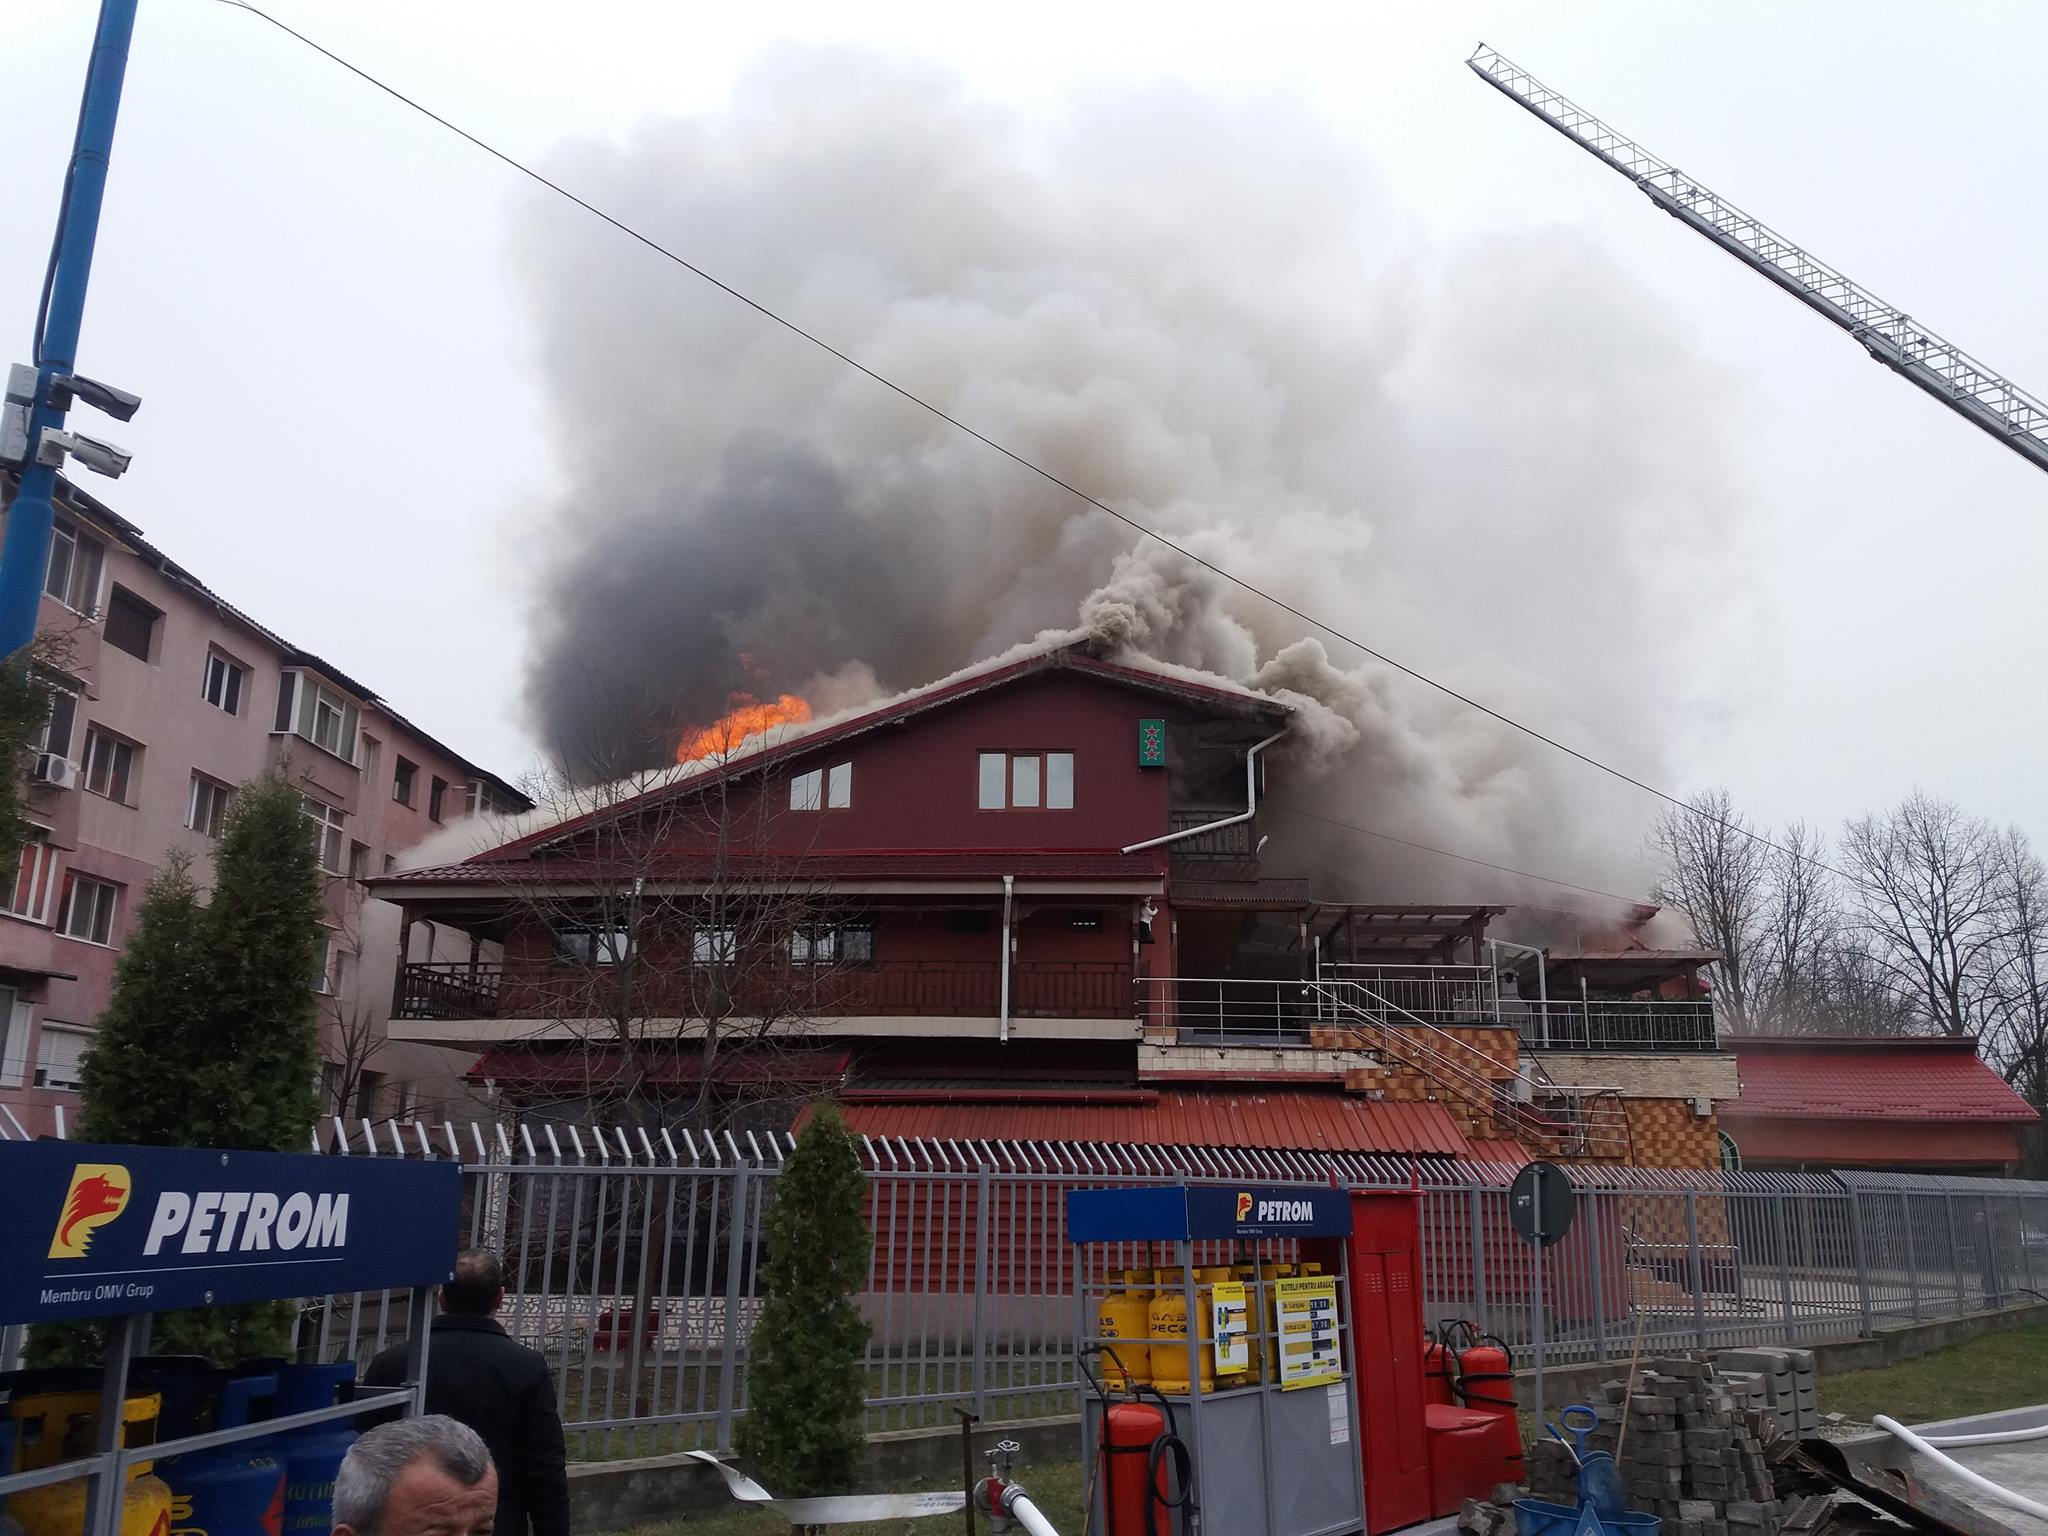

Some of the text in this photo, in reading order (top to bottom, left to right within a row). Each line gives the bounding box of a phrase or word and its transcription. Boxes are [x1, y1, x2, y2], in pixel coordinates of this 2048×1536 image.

[1258, 1201, 1313, 1222] PETROM
[143, 1192, 349, 1256] PETROM
[40, 1283, 154, 1304] Membru OMV Grup
[1299, 1282, 1316, 1290] PENTRU
[1099, 1317, 1114, 1326] AS
